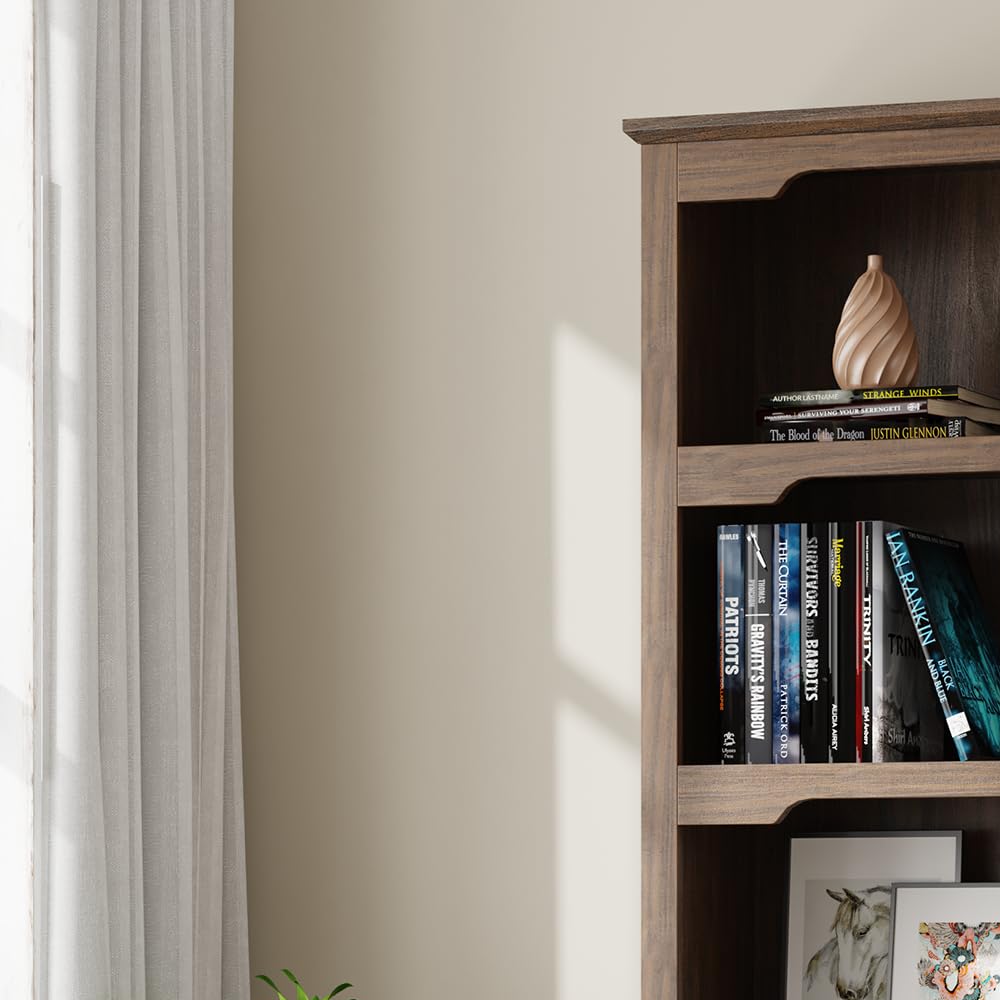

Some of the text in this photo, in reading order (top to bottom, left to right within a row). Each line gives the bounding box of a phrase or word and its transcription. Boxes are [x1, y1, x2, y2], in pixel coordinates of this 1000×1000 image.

[772, 393, 839, 403] AUTHOR LASTNAME
[797, 408, 843, 418] SURVIVING
[863, 387, 942, 400] STRANGE WINDS
[769, 426, 865, 442] The Blood of the Dragon
[870, 425, 947, 440] JUSTIN GLENNON
[779, 539, 789, 616] THE CURTAIN
[831, 538, 844, 588] Marriage
[757, 578, 765, 604] THOMAS
[886, 531, 911, 576] IAN
[899, 570, 936, 647] RANKIN
[725, 596, 739, 676] PATRIOTS
[805, 537, 819, 702] SURVIVORS AND BANDITS
[863, 594, 872, 667] TRINITY
[926, 658, 948, 704] AND BLUE
[937, 658, 955, 691] BLACK
[750, 685, 765, 740] RAINBOW
[780, 684, 788, 759] PATRICK ORD
